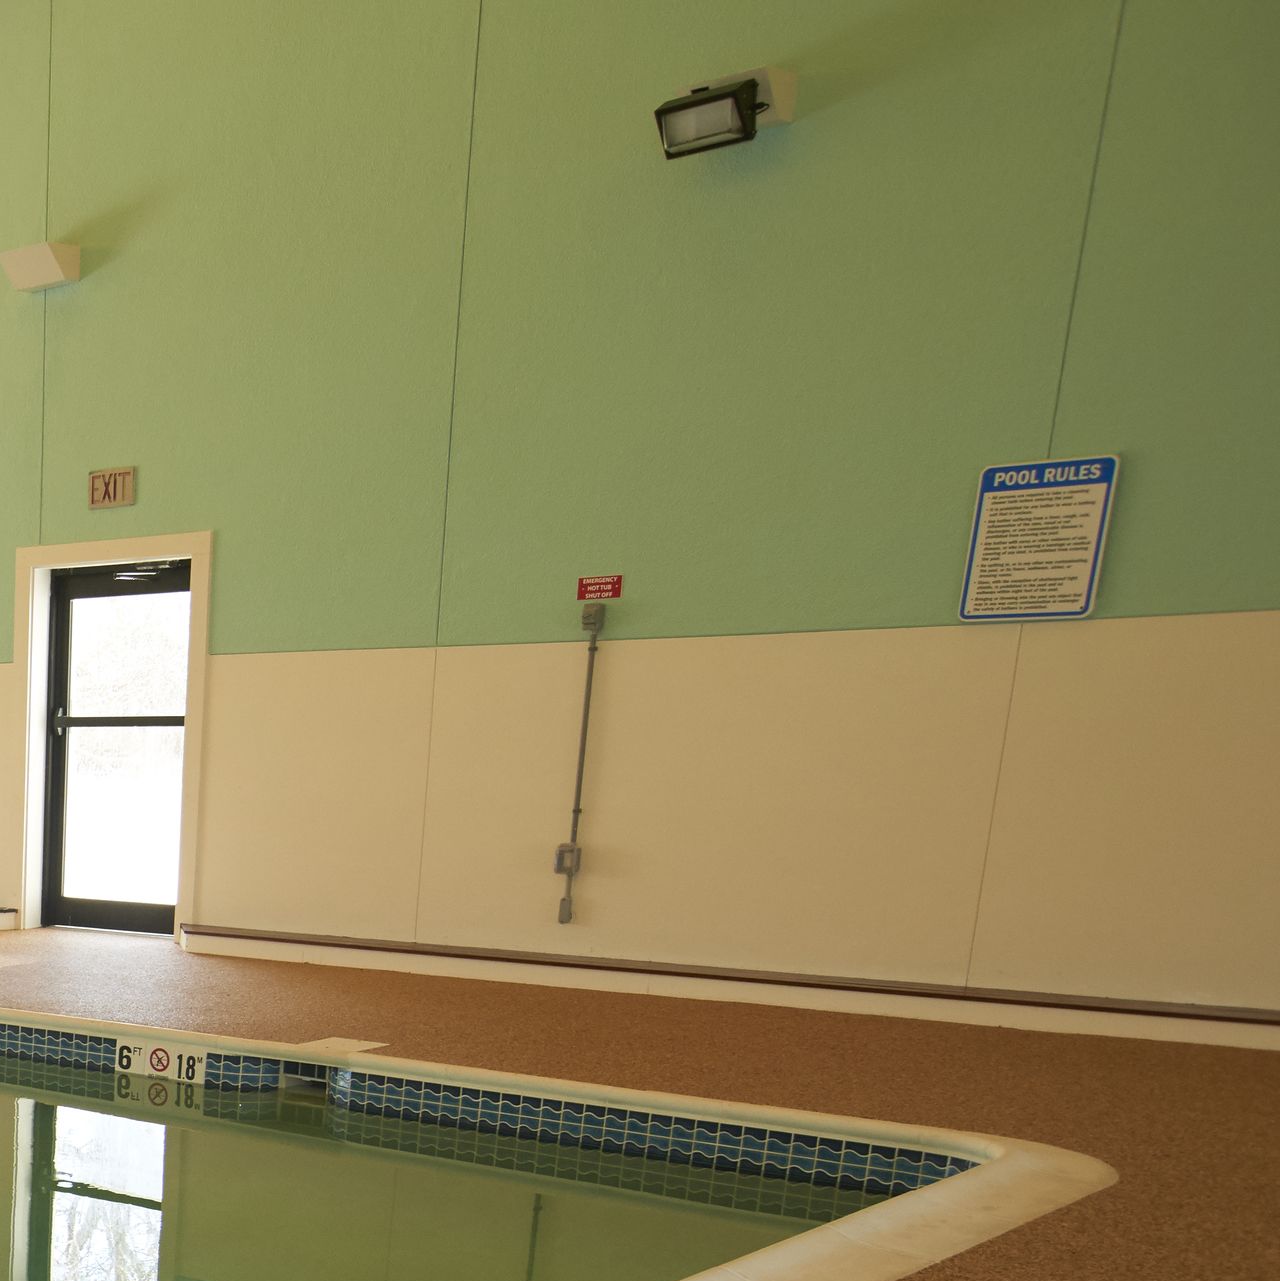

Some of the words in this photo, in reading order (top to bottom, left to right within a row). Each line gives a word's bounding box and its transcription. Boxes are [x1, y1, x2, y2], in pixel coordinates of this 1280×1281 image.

[91, 472, 131, 504] EXIT
[994, 470, 1039, 487] POOL
[1044, 464, 1101, 483] RULES
[118, 1046, 132, 1070] 6
[133, 1047, 143, 1056] FT
[177, 1054, 196, 1080] 1.8
